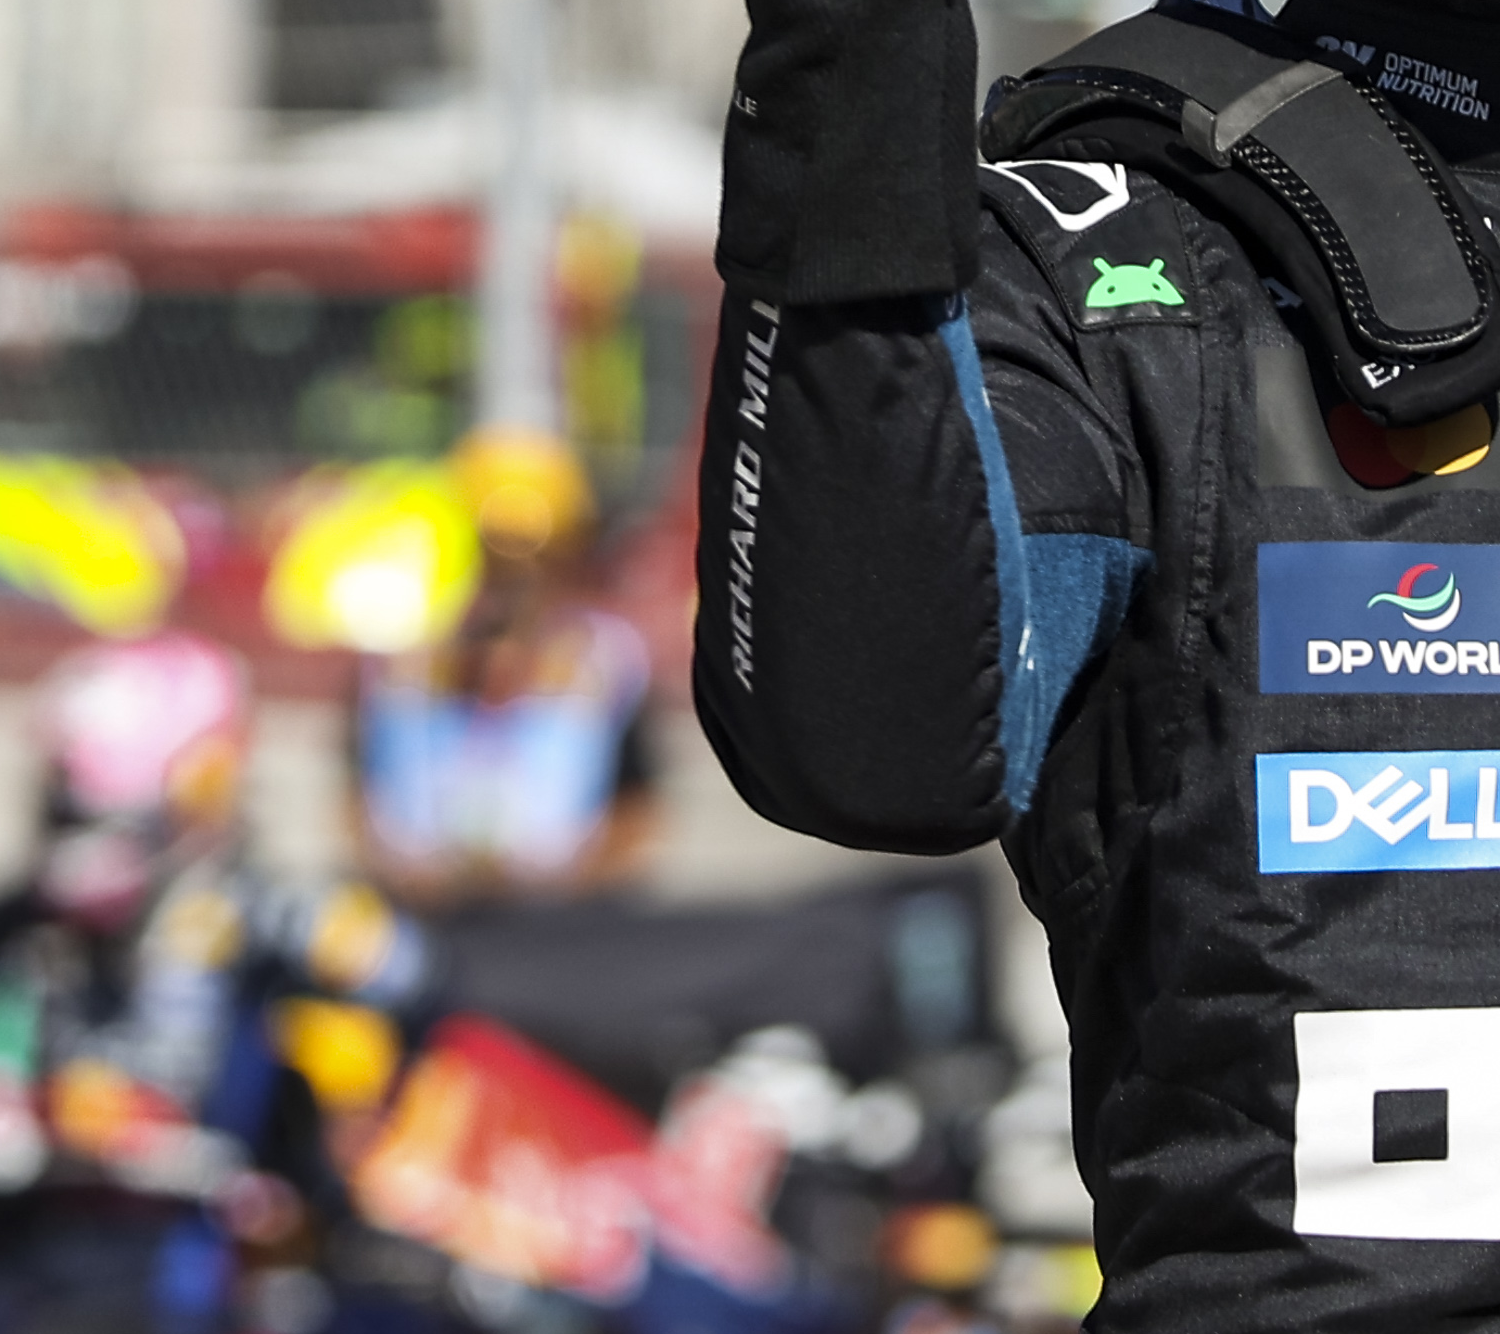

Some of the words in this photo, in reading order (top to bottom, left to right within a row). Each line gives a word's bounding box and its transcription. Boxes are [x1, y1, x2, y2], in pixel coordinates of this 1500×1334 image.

[1376, 70, 1491, 122] NUTRITION
[1384, 51, 1479, 98] OPTIMUM
[738, 299, 781, 431] MILL
[729, 439, 764, 693] RICHARD
[1306, 641, 1373, 674] DP
